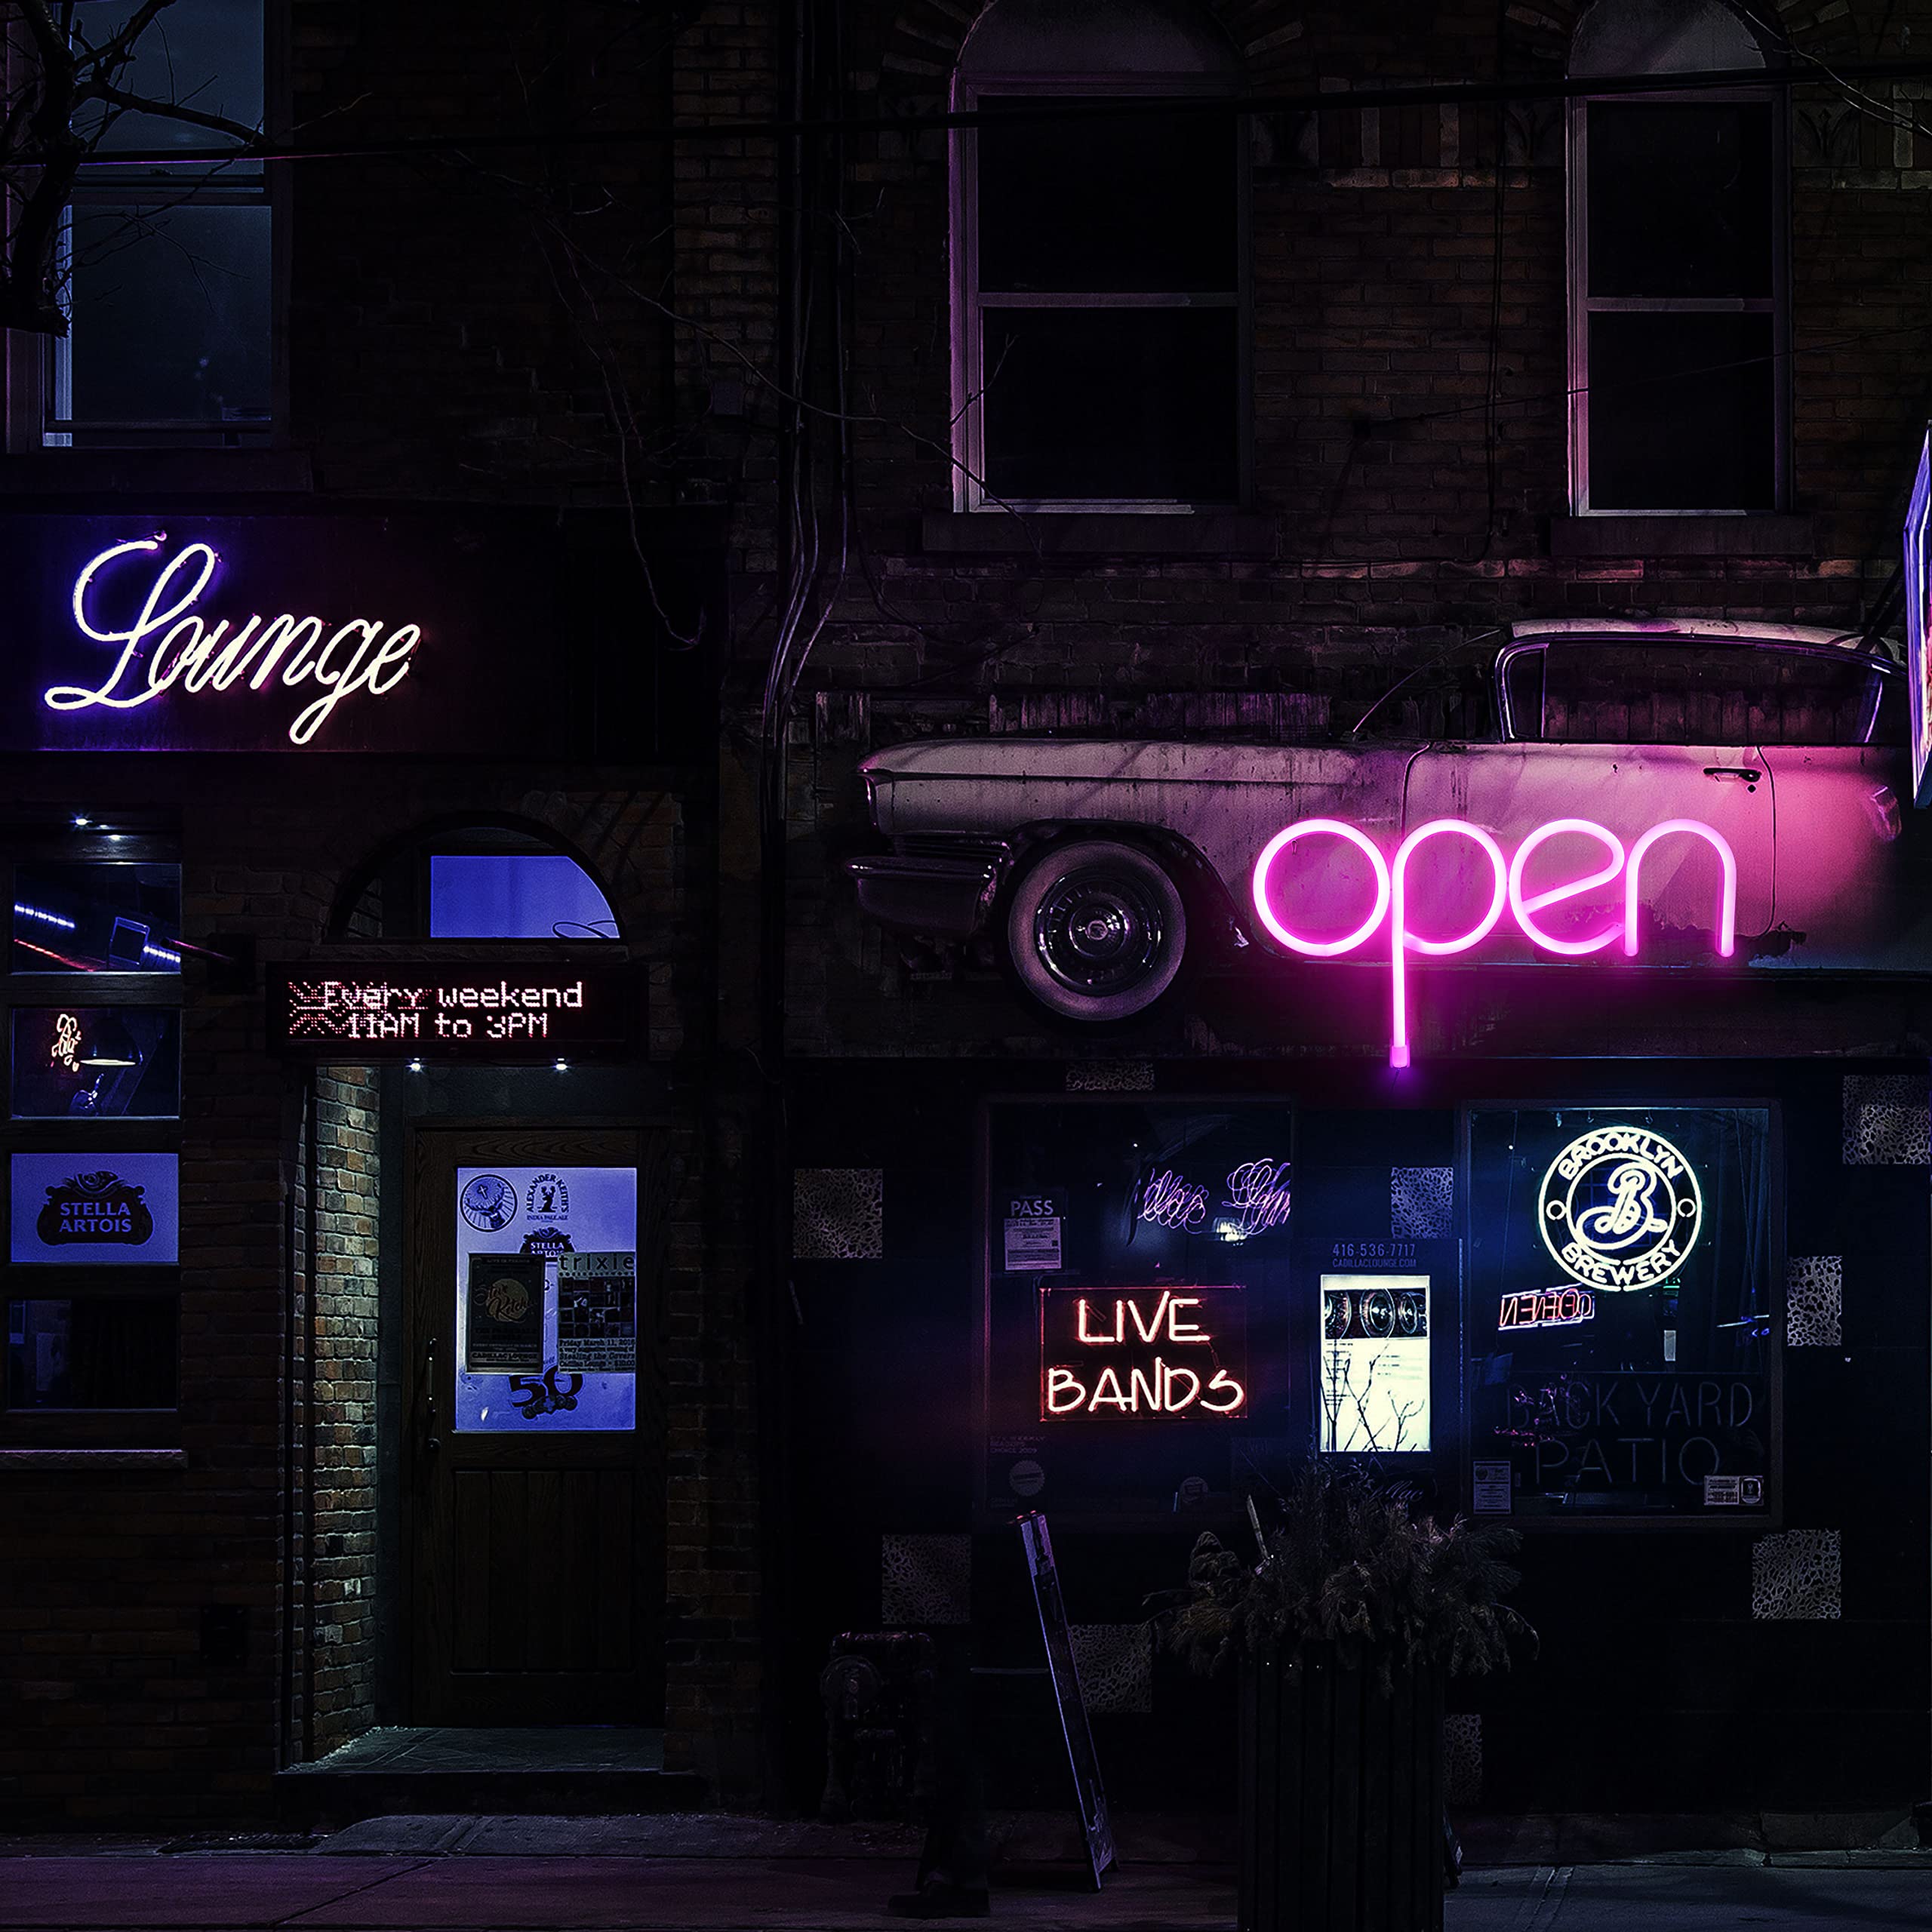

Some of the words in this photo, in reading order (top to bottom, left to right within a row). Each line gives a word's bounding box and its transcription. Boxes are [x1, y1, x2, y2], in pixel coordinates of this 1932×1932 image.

[45, 540, 421, 745] Lounge
[1252, 817, 1737, 1069] open
[324, 981, 424, 1008] Every
[438, 980, 583, 1008] weekend
[348, 1012, 420, 1038] 11AM
[435, 1012, 472, 1038] to
[485, 1012, 549, 1038] 3PM
[1558, 1131, 1684, 1181] BROOKLYN
[60, 1202, 131, 1216] STELLA
[526, 1174, 557, 1212] ALEXANDER
[1010, 1199, 1054, 1217] PASS
[59, 1219, 132, 1232] ARTOIS
[558, 1254, 635, 1271] trixie
[1332, 1243, 1416, 1257] 416-536-7717
[1561, 1238, 1681, 1286] BREWERY
[1078, 1291, 1211, 1343] LIVE
[1048, 1356, 1245, 1413] BANDS
[1636, 1381, 1754, 1429] YARD
[1534, 1436, 1721, 1485] PATIO
